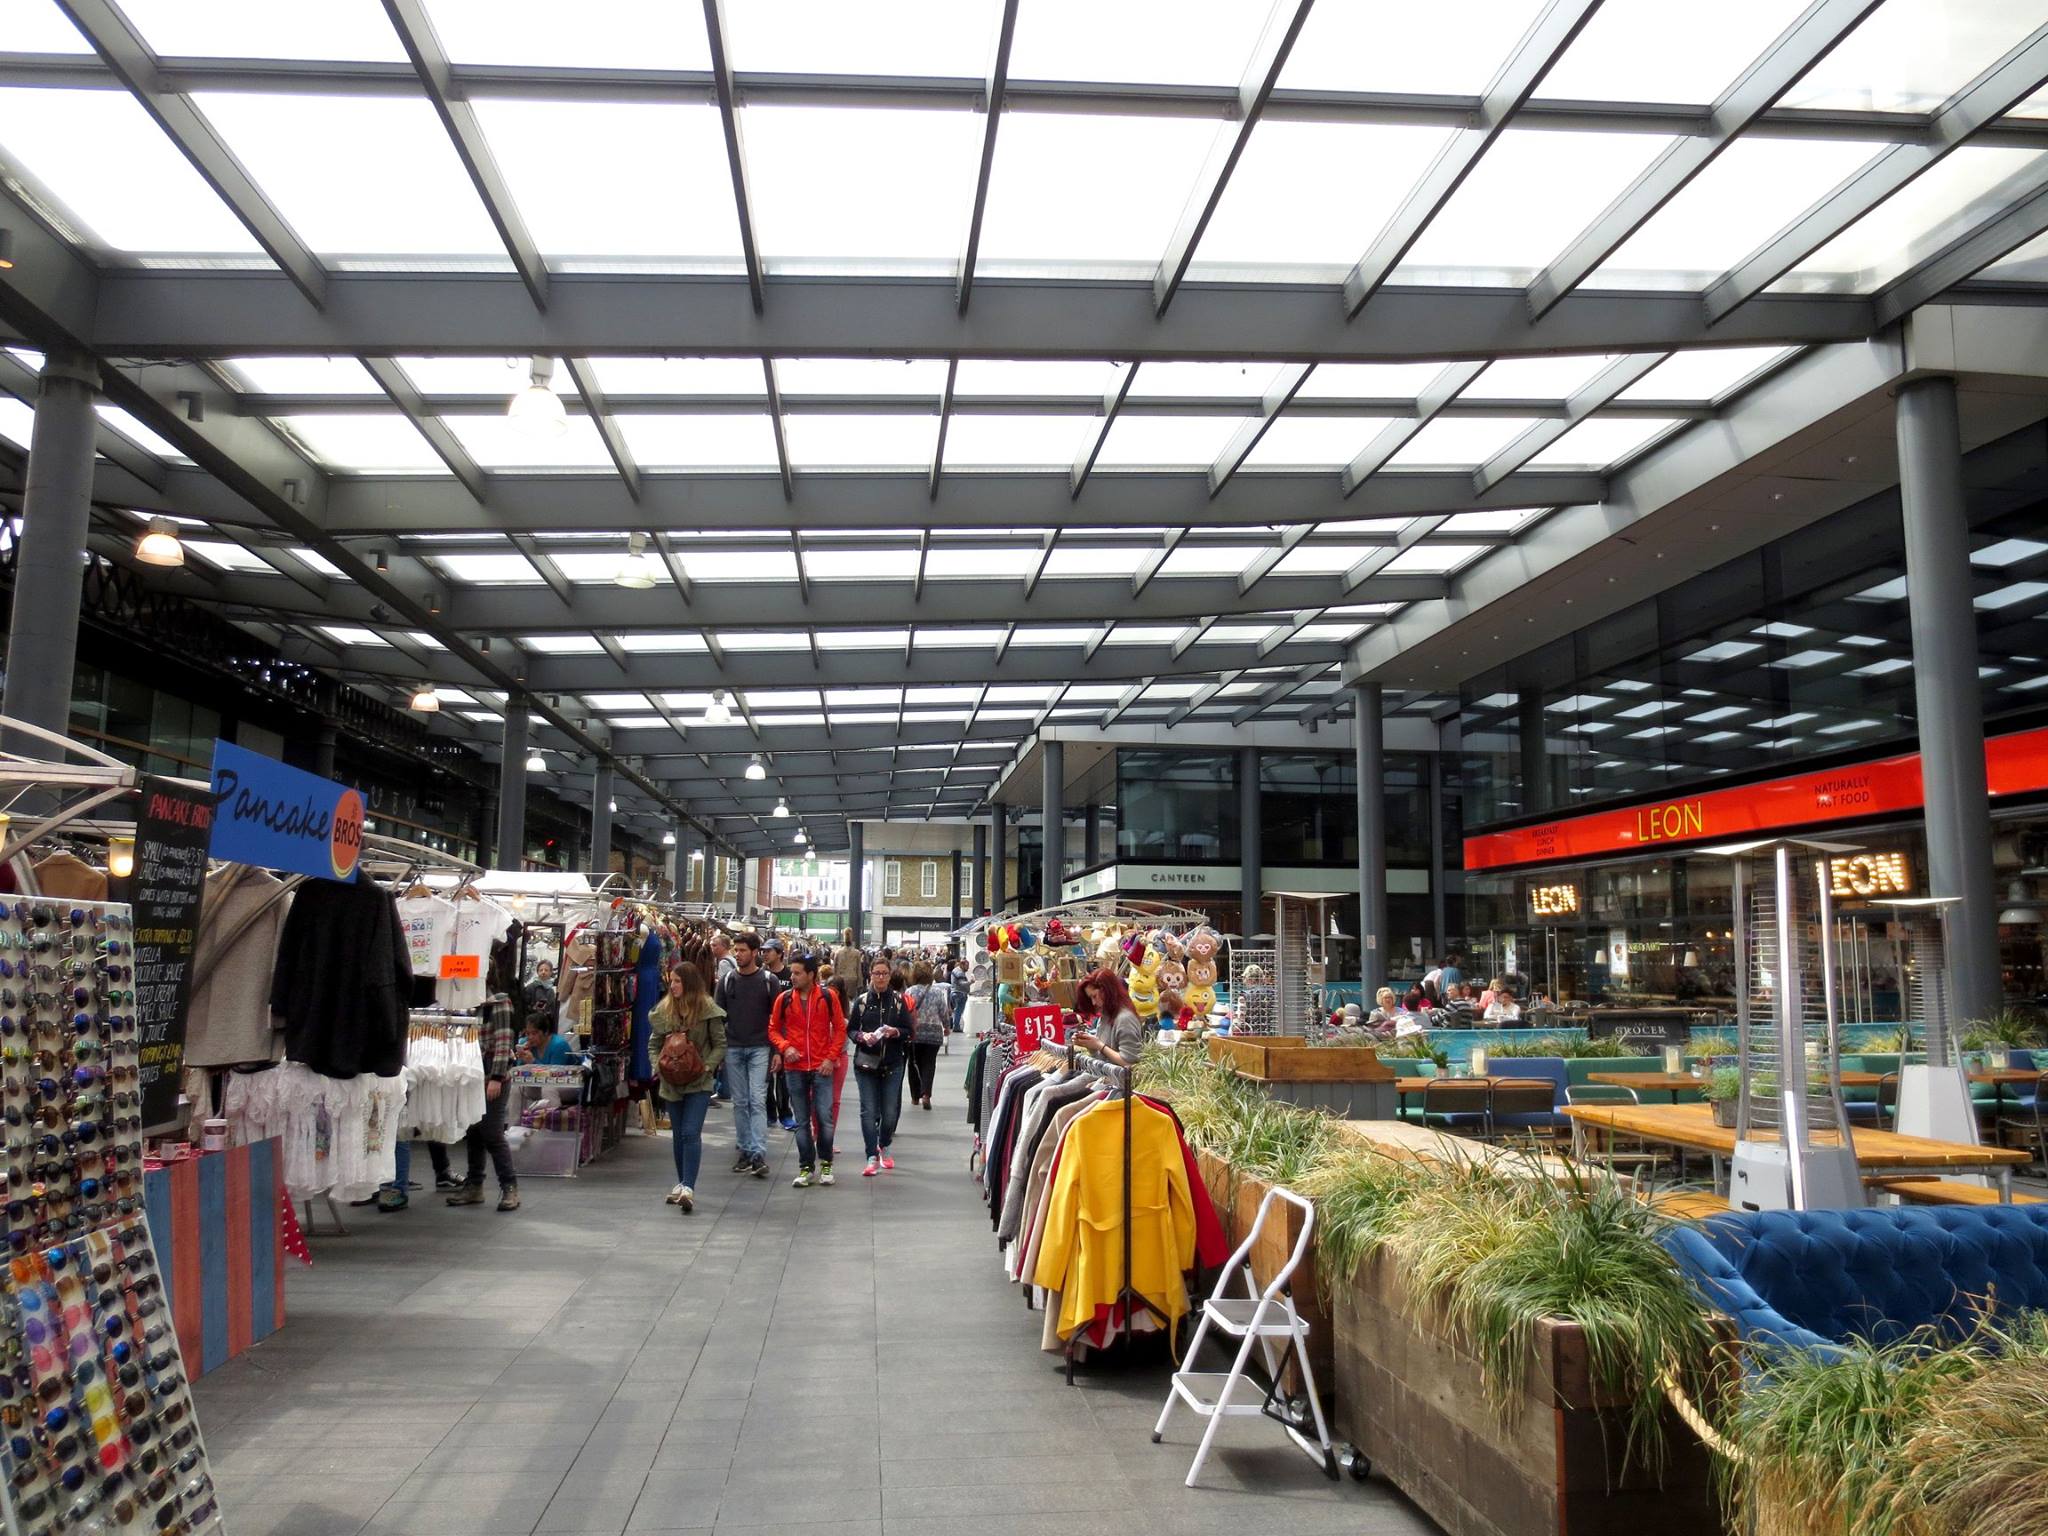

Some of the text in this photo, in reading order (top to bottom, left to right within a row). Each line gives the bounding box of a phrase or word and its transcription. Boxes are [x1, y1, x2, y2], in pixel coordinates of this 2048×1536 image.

[1814, 776, 1871, 794] NATURALLY
[214, 768, 330, 842] Pancake
[1840, 791, 1870, 805] FOOD
[1638, 801, 1702, 841] LEON
[333, 818, 362, 847] BROS
[1151, 873, 1206, 883] CANTEEN
[1532, 884, 1576, 914] LEON
[135, 946, 161, 963] UTELLA
[1024, 1014, 1056, 1041] £15
[1615, 1025, 1667, 1035] GROCER
